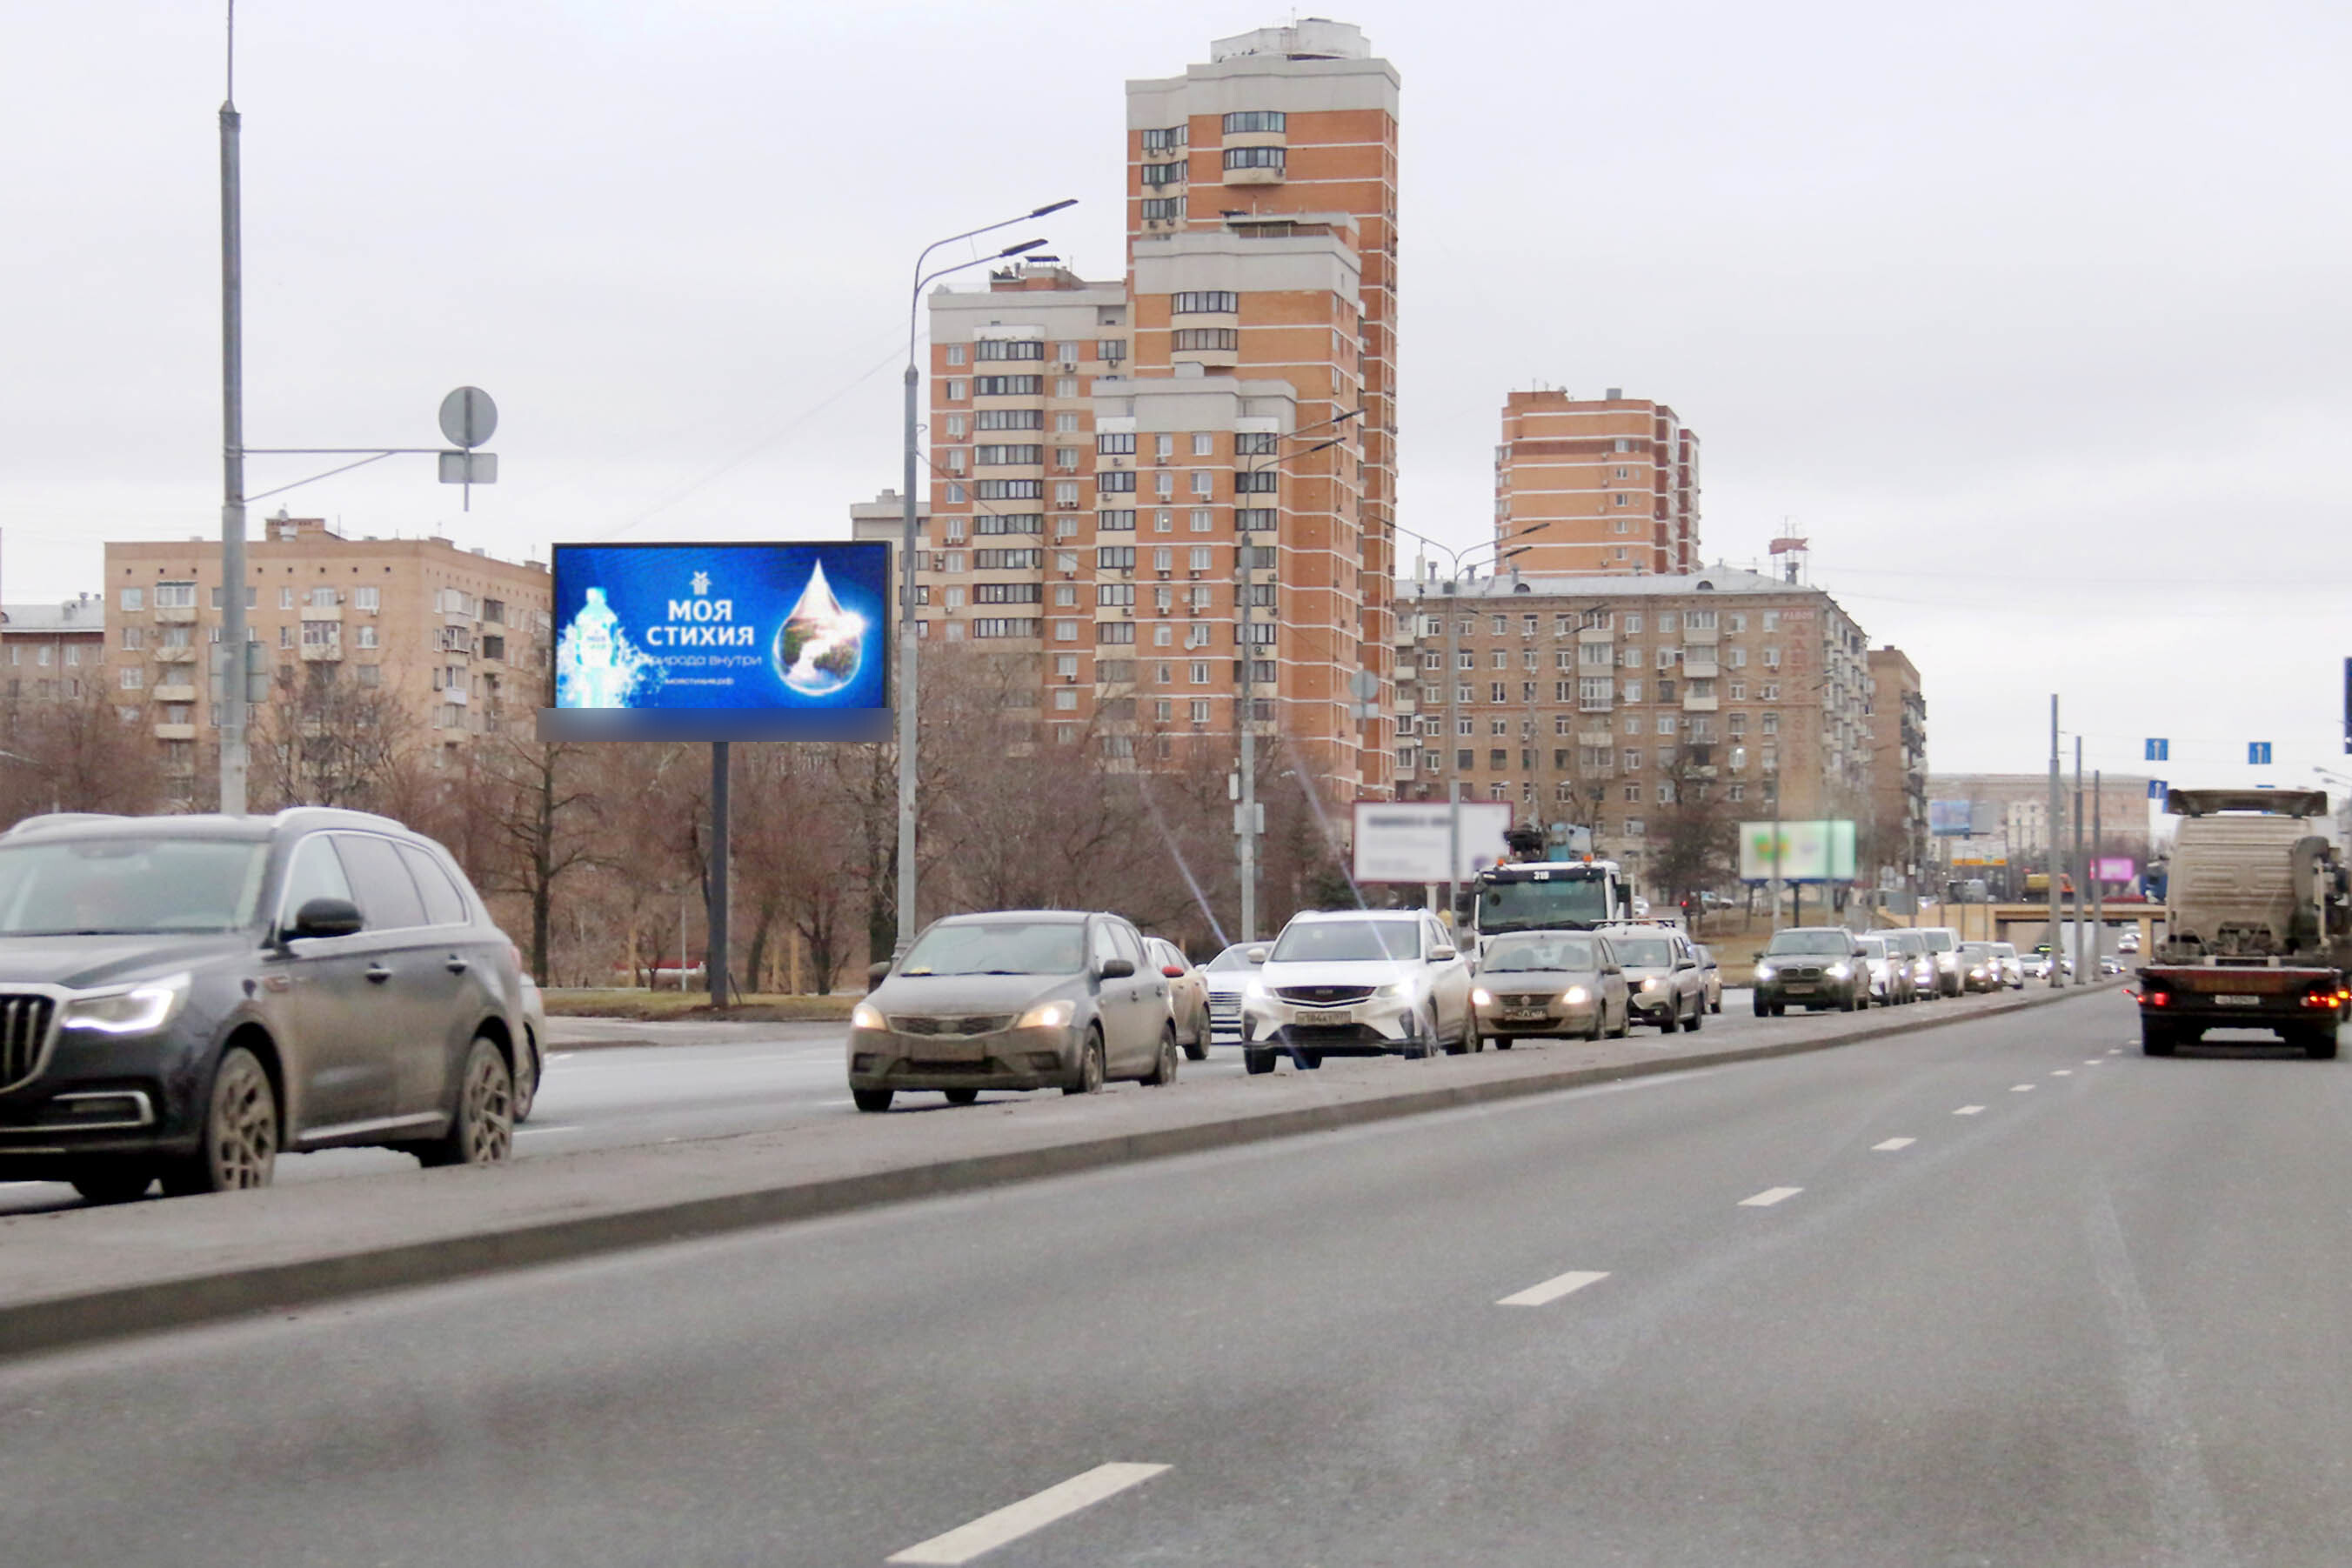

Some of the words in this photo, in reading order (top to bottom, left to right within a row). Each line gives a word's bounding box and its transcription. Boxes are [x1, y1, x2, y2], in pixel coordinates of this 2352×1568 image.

[668, 600, 732, 622] МОЯ
[646, 626, 754, 646] СТИХИЯ
[648, 655, 706, 667] рирода
[709, 655, 763, 669] внутри
